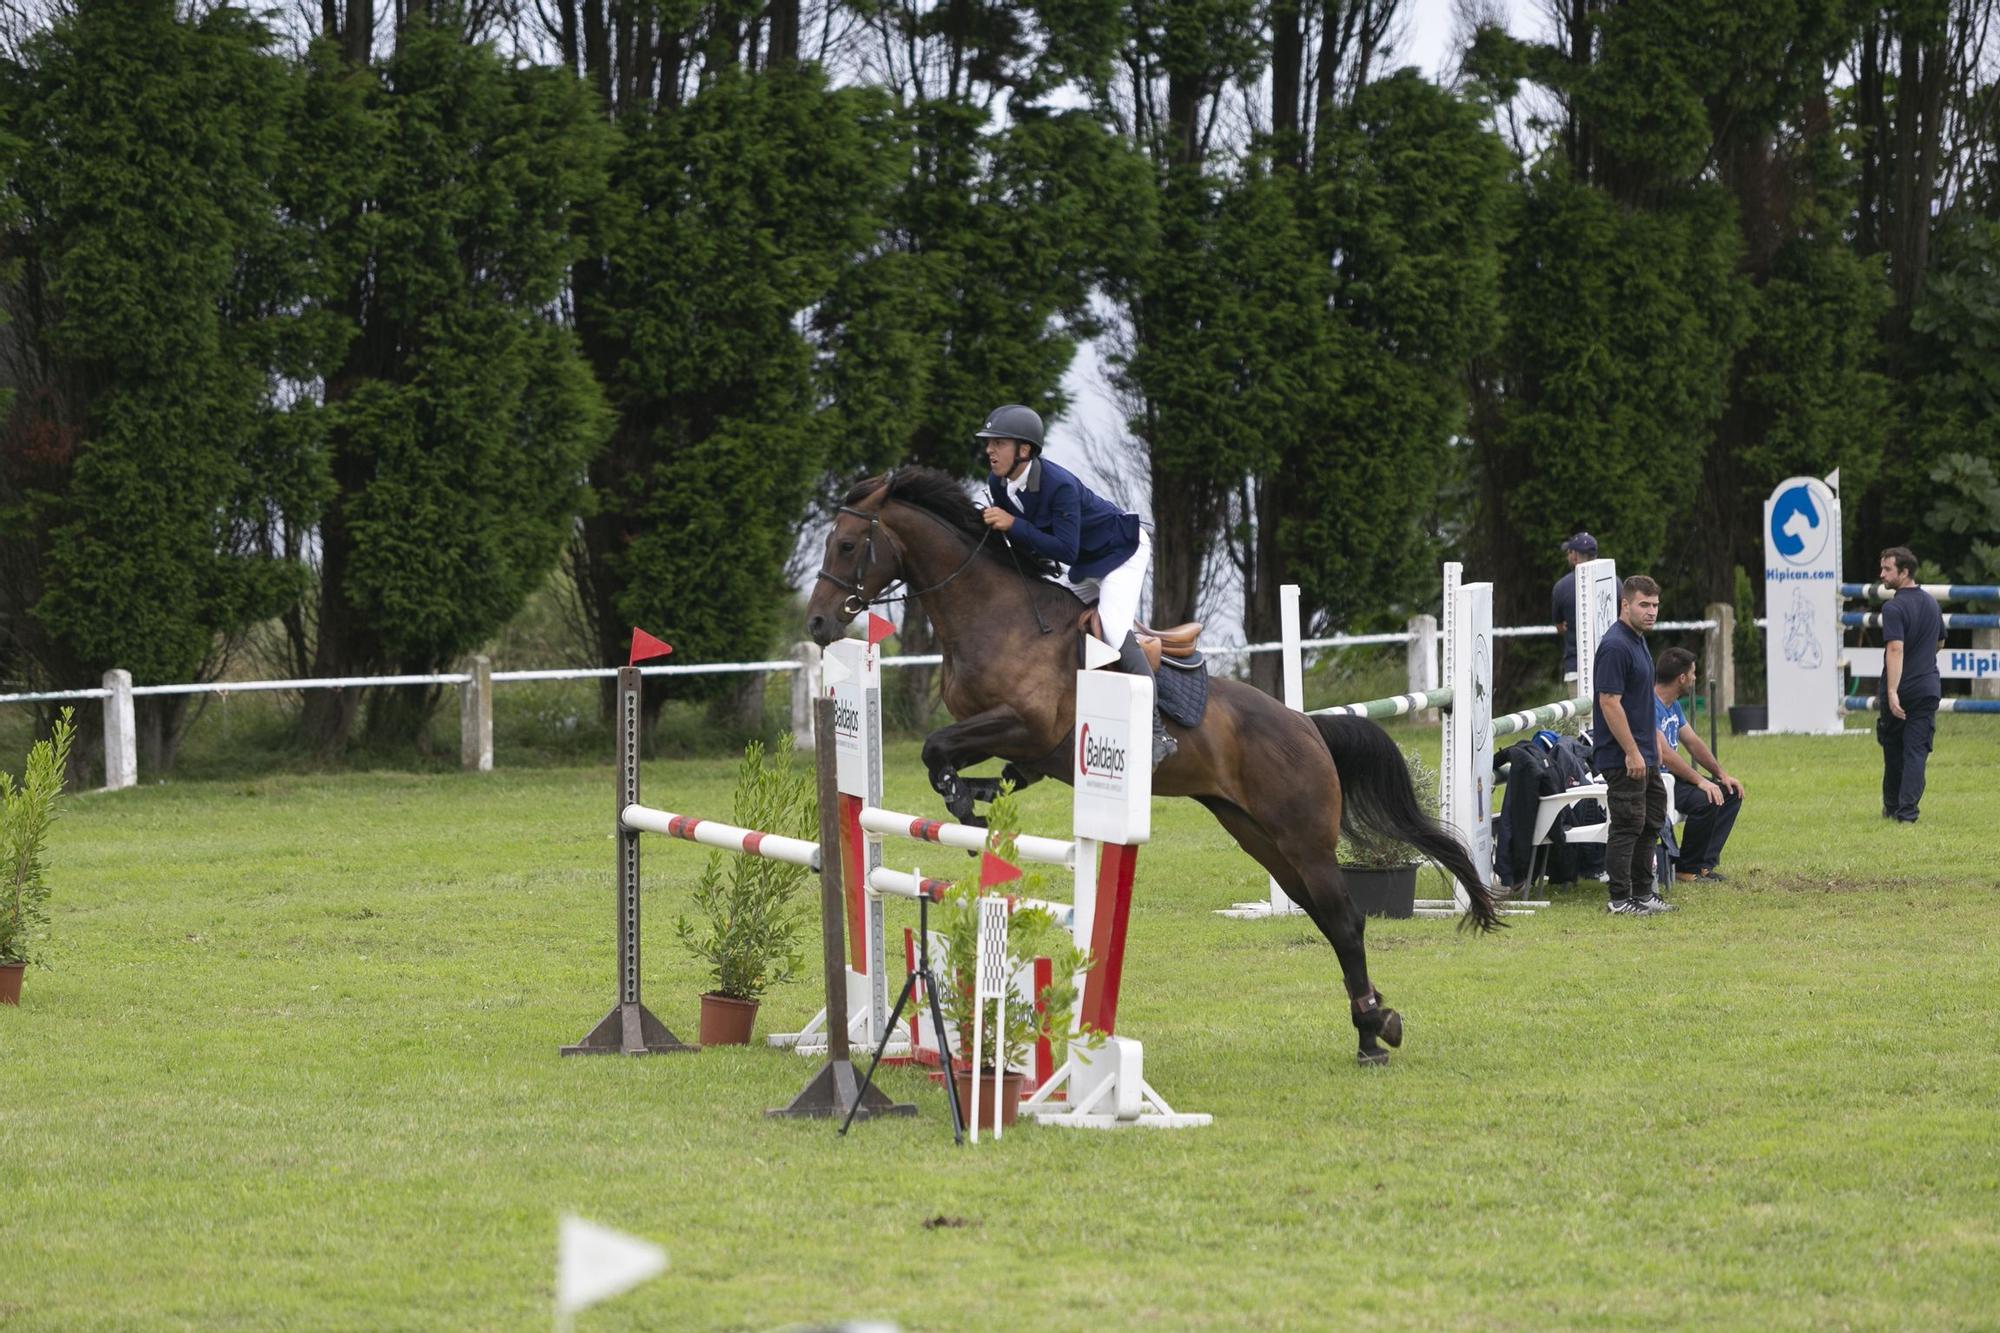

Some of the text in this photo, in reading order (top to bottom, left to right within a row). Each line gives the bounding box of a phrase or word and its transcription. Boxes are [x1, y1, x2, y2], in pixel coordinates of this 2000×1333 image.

[1766, 568, 1834, 582] Hipican.com
[1951, 652, 2000, 677] Hipi
[1086, 735, 1125, 779] Baldajos
